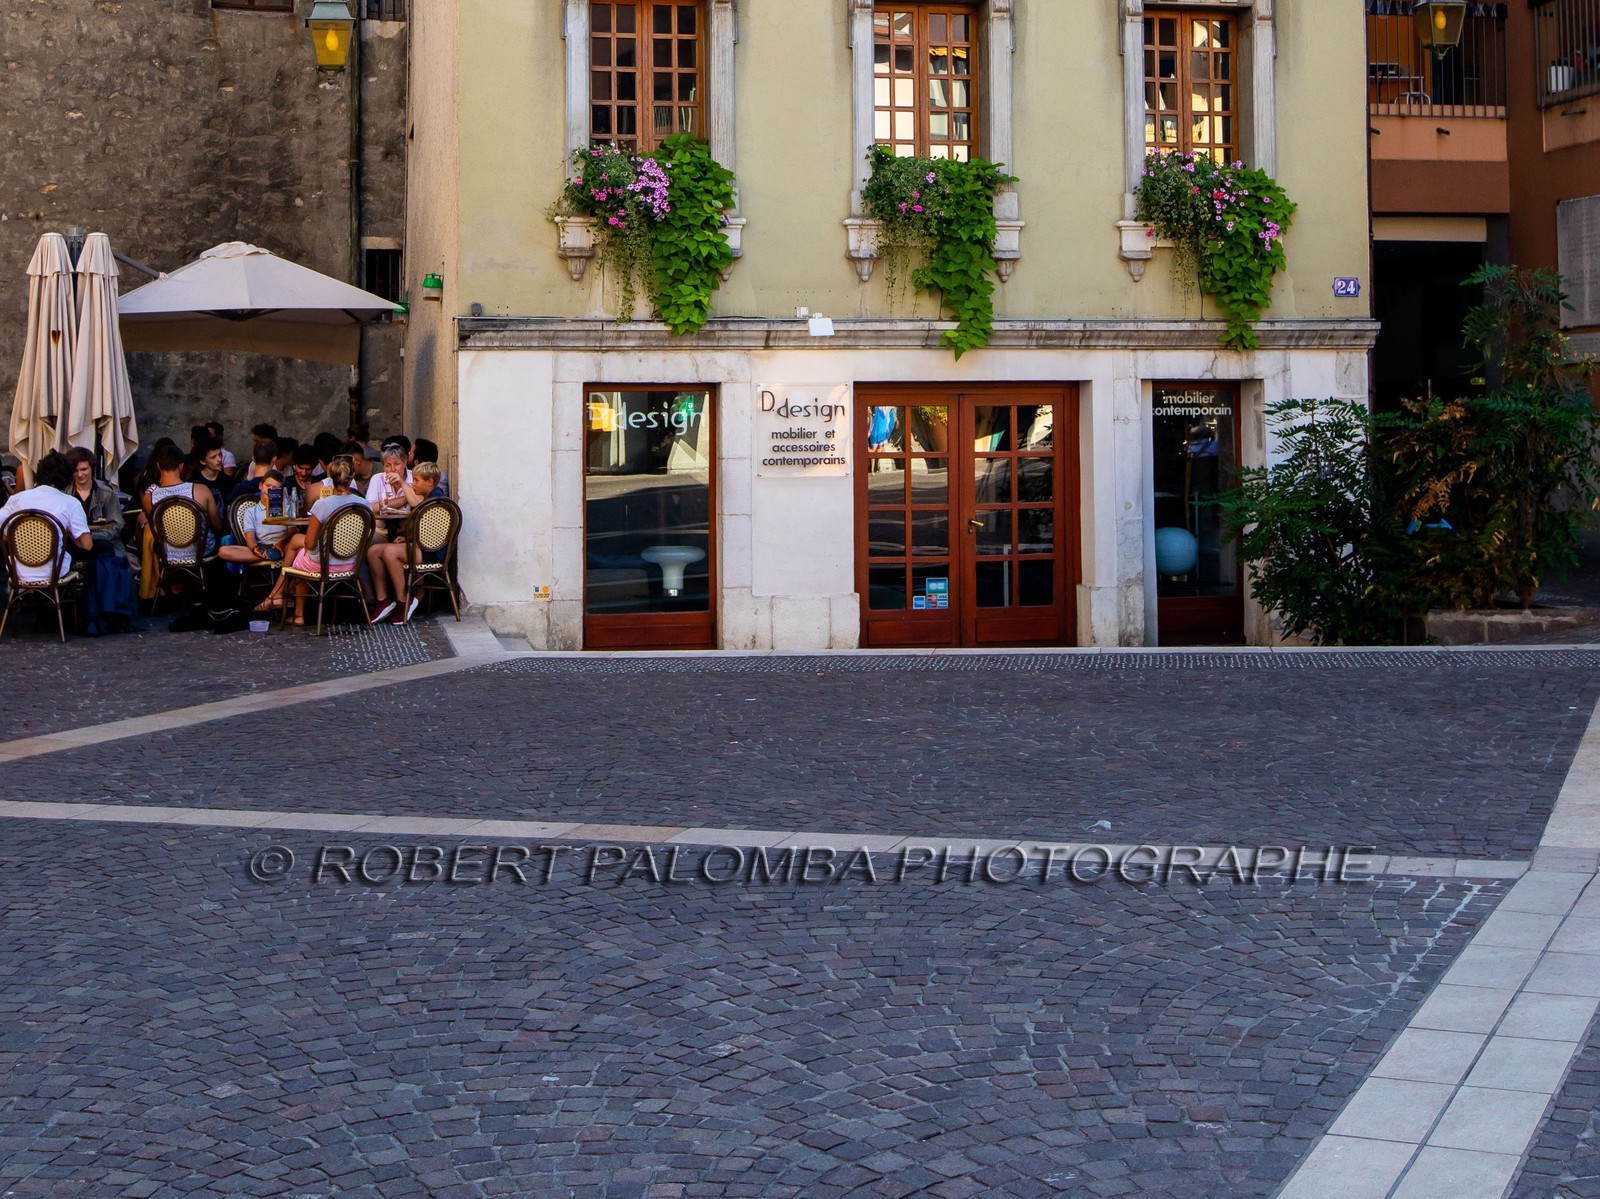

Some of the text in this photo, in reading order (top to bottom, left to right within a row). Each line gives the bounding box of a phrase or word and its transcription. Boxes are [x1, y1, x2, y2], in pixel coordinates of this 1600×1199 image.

[1337, 280, 1356, 295] 24
[1164, 390, 1215, 404] mobilier
[1152, 403, 1232, 418] ontemporain
[771, 426, 836, 440] mobilier et
[771, 441, 836, 453] accessoires
[762, 454, 846, 468] contemporains
